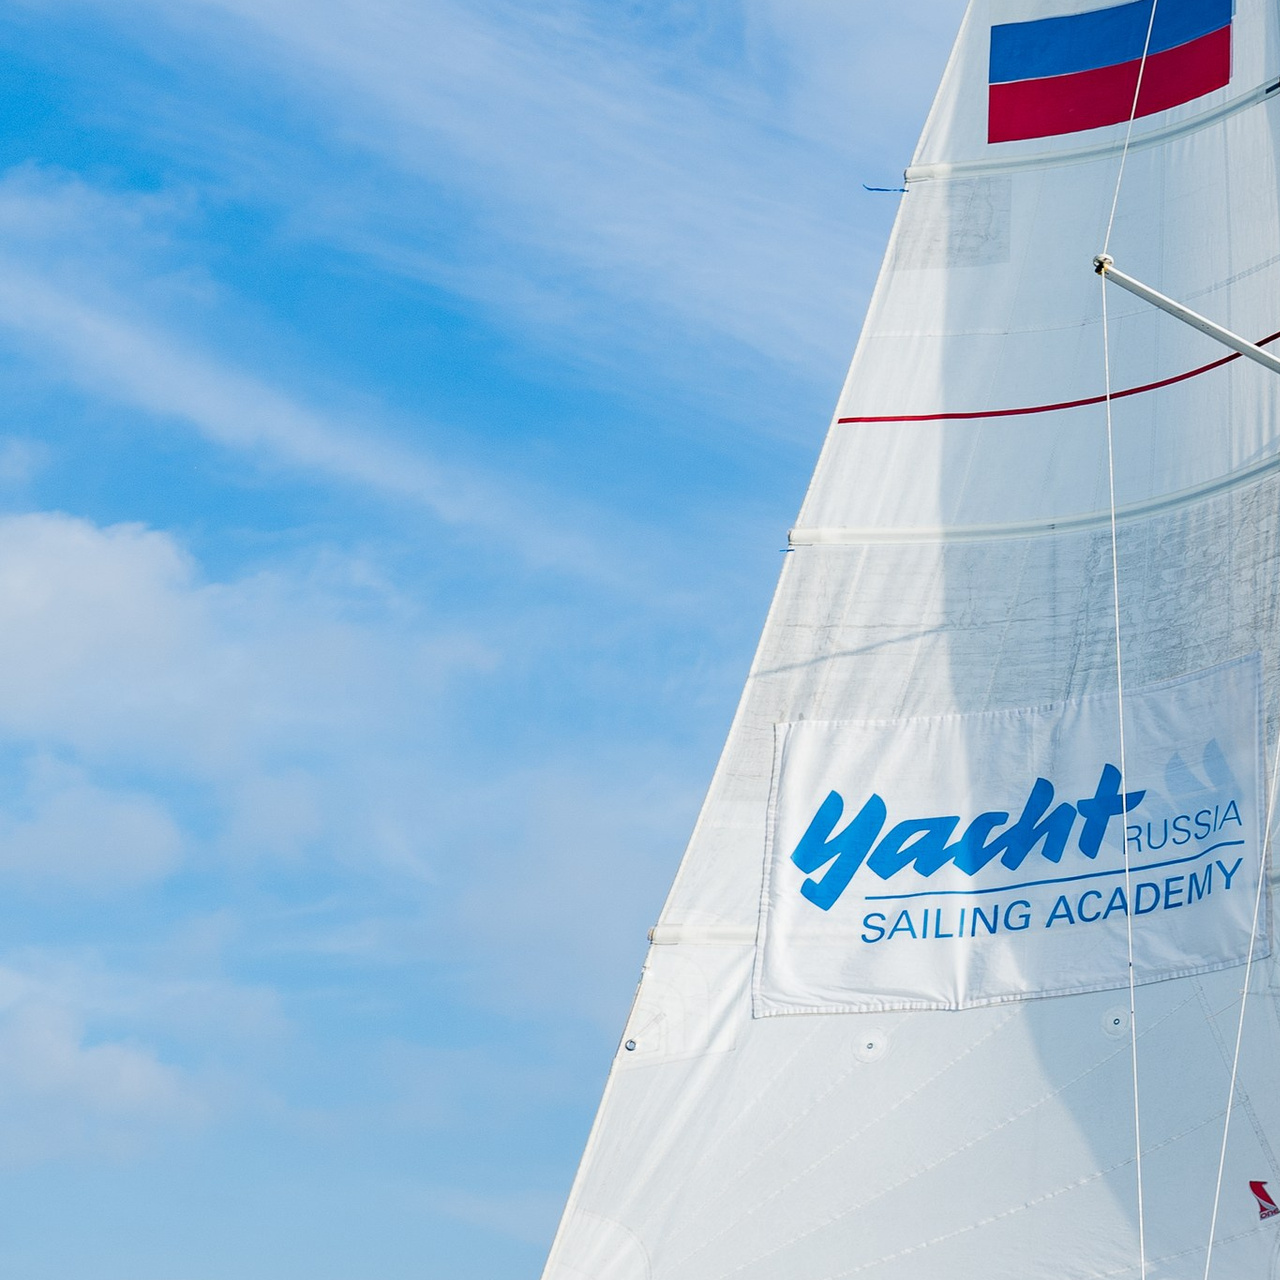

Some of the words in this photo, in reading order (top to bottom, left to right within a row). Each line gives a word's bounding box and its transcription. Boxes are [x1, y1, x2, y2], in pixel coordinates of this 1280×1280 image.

[1123, 799, 1242, 855] RUSSIA
[860, 899, 1031, 944] SAILING
[1045, 857, 1244, 929] ACADEMY
